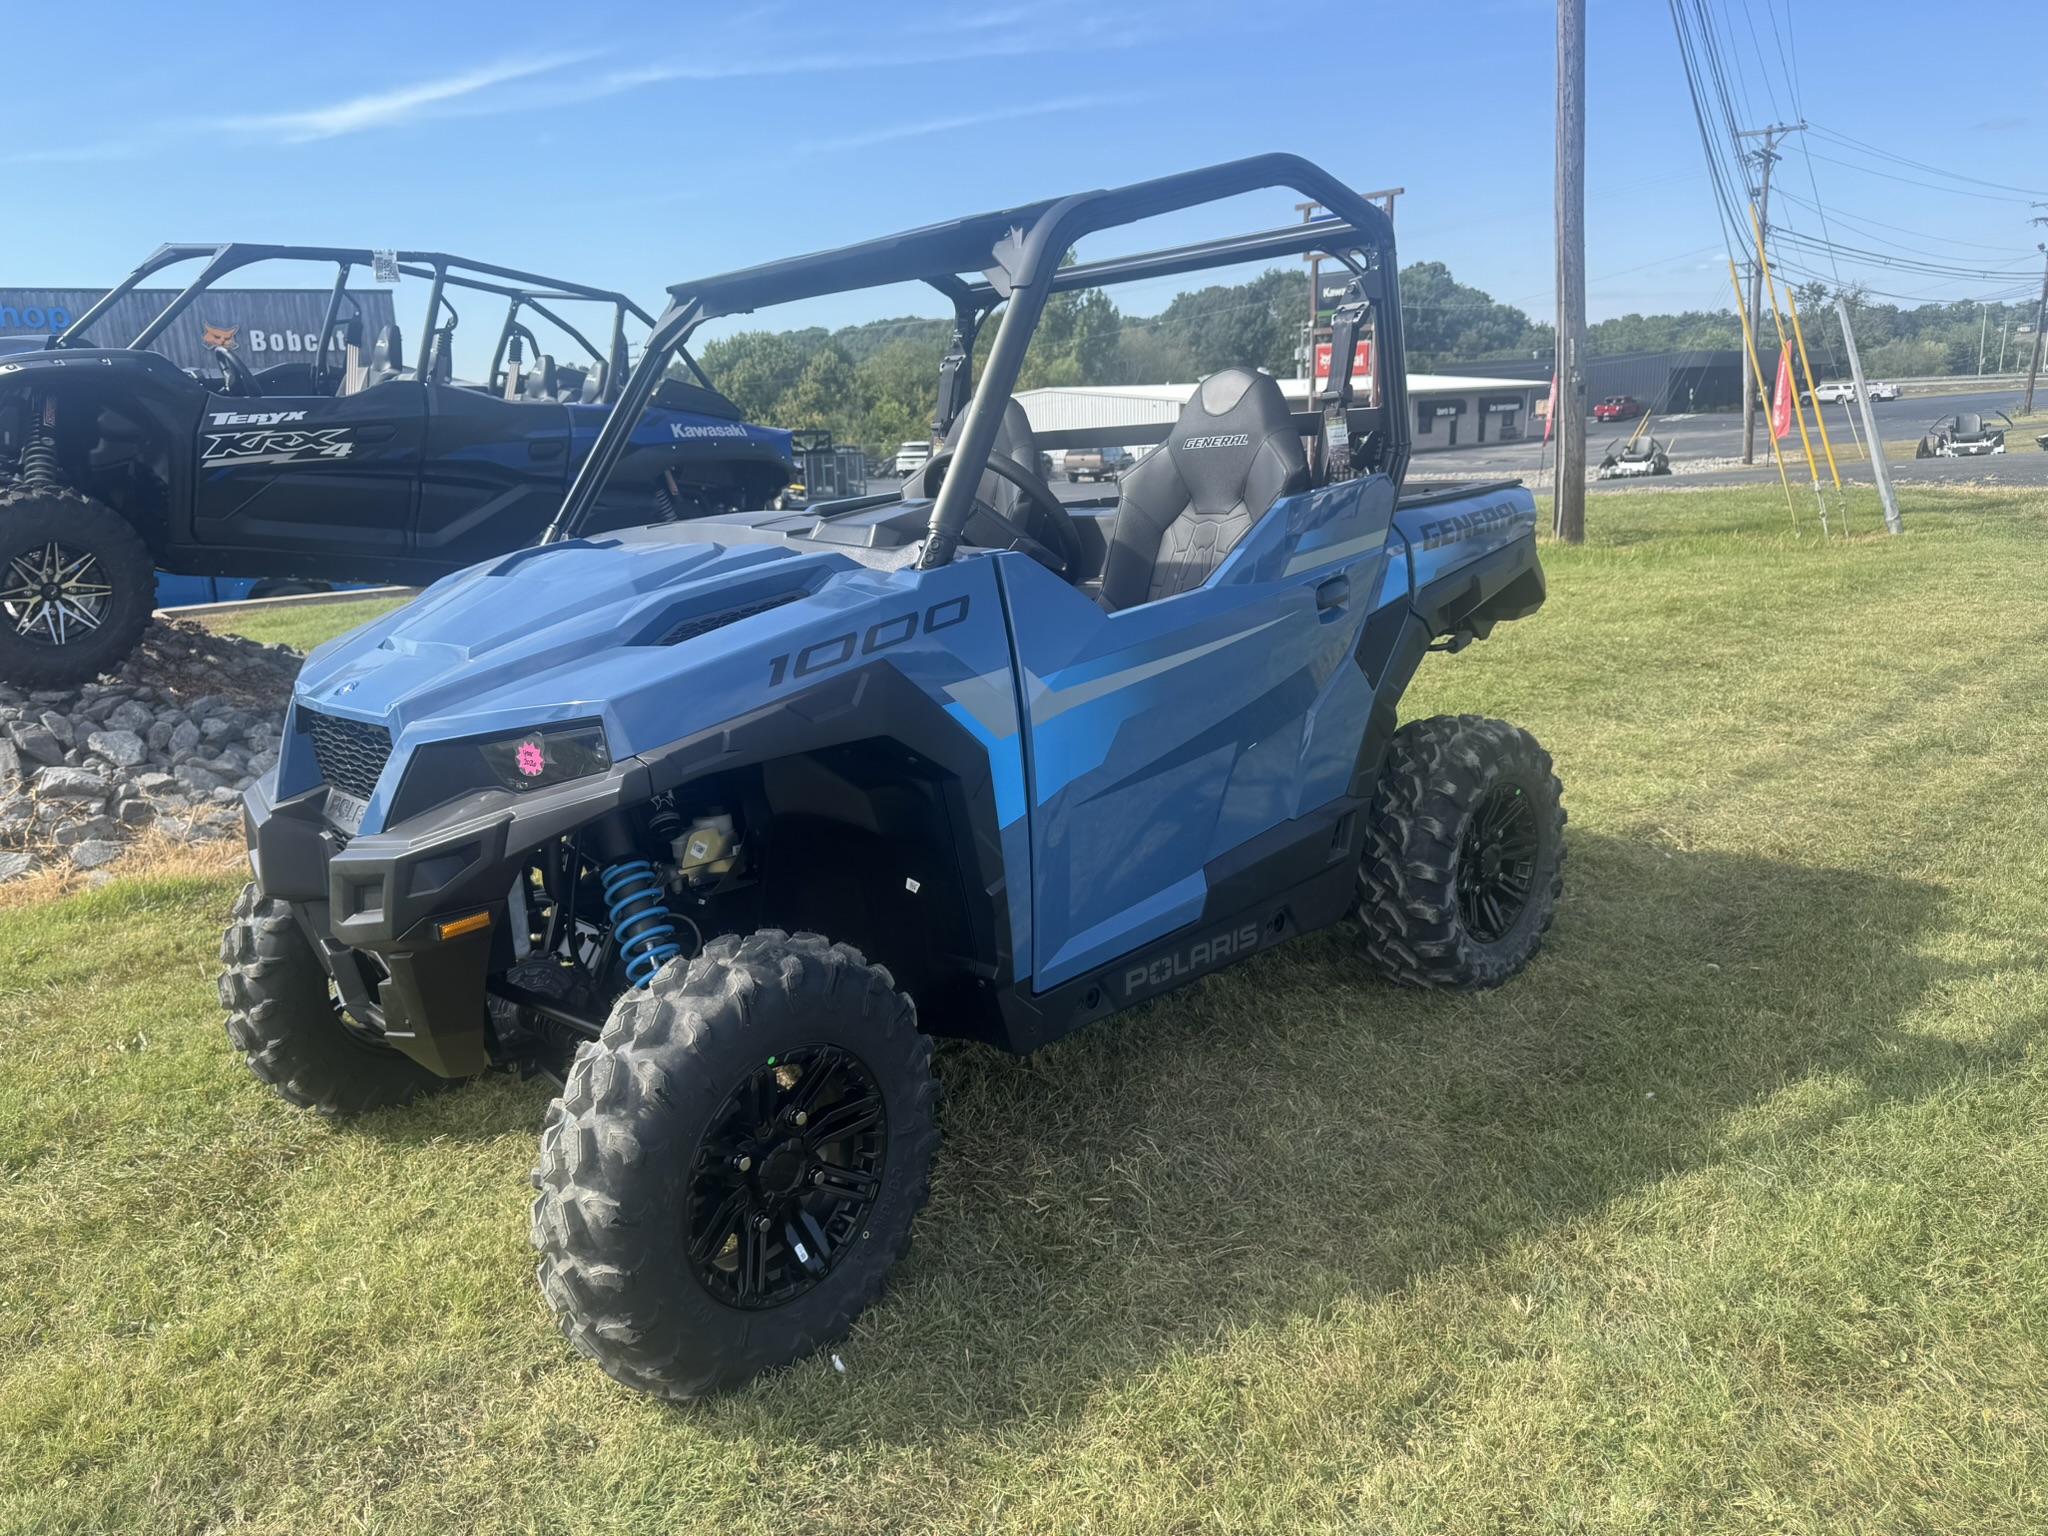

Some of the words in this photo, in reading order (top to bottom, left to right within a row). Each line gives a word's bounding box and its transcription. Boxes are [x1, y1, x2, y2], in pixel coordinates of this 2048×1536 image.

[0, 303, 71, 334] hop
[670, 423, 748, 438] Kawasaki
[1182, 433, 1249, 450] GENERAL
[1419, 501, 1525, 552] GENERAL
[767, 594, 971, 689] 1000
[1125, 922, 1259, 997] POLARIS
